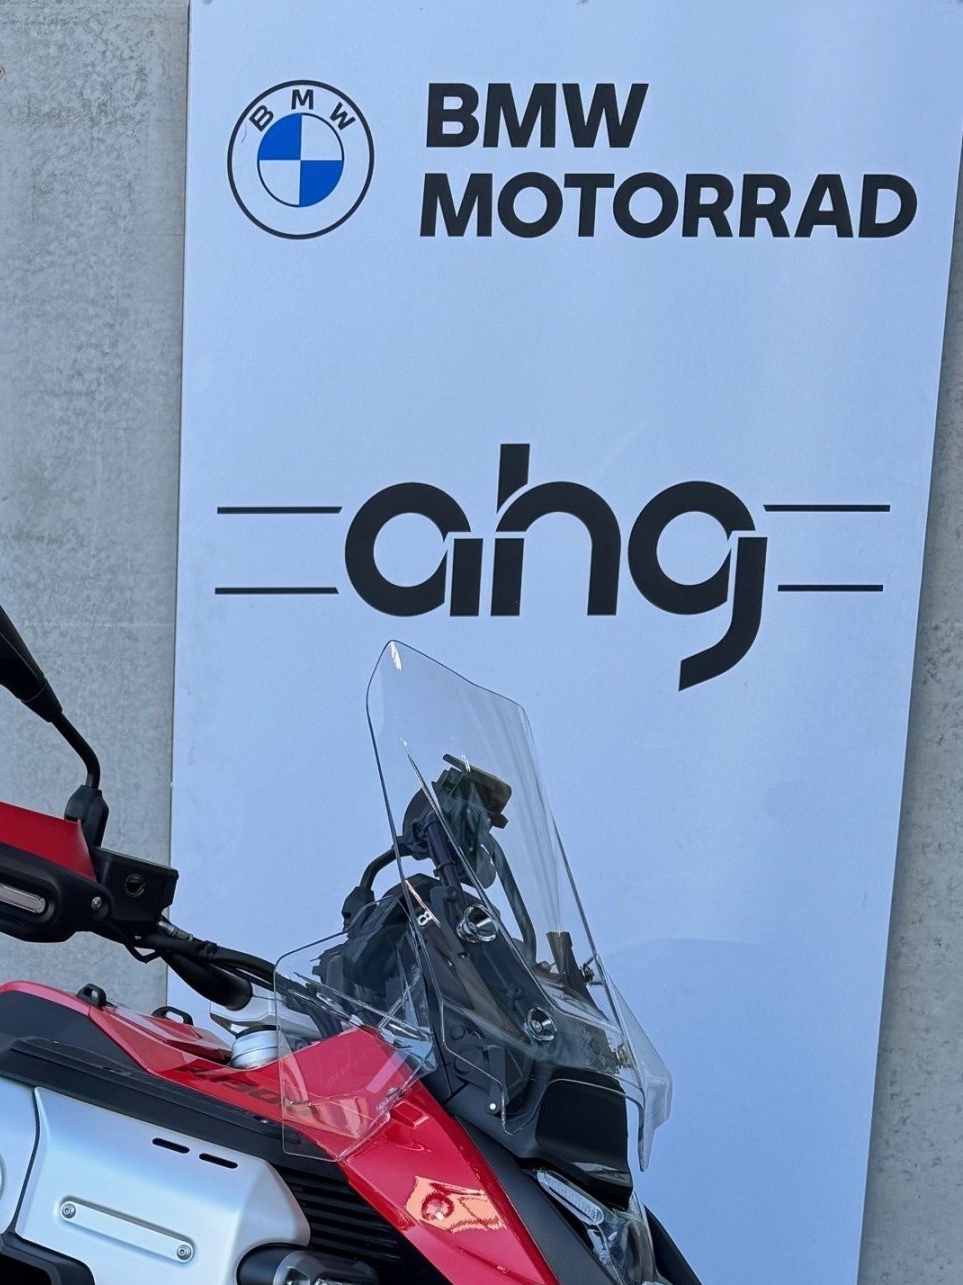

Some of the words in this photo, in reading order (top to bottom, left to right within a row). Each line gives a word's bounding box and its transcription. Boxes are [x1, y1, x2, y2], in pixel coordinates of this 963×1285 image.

[249, 88, 356, 132] BMW
[426, 83, 649, 148] BMW
[420, 172, 917, 238] MOTORRAD
[345, 444, 769, 692] ahg
